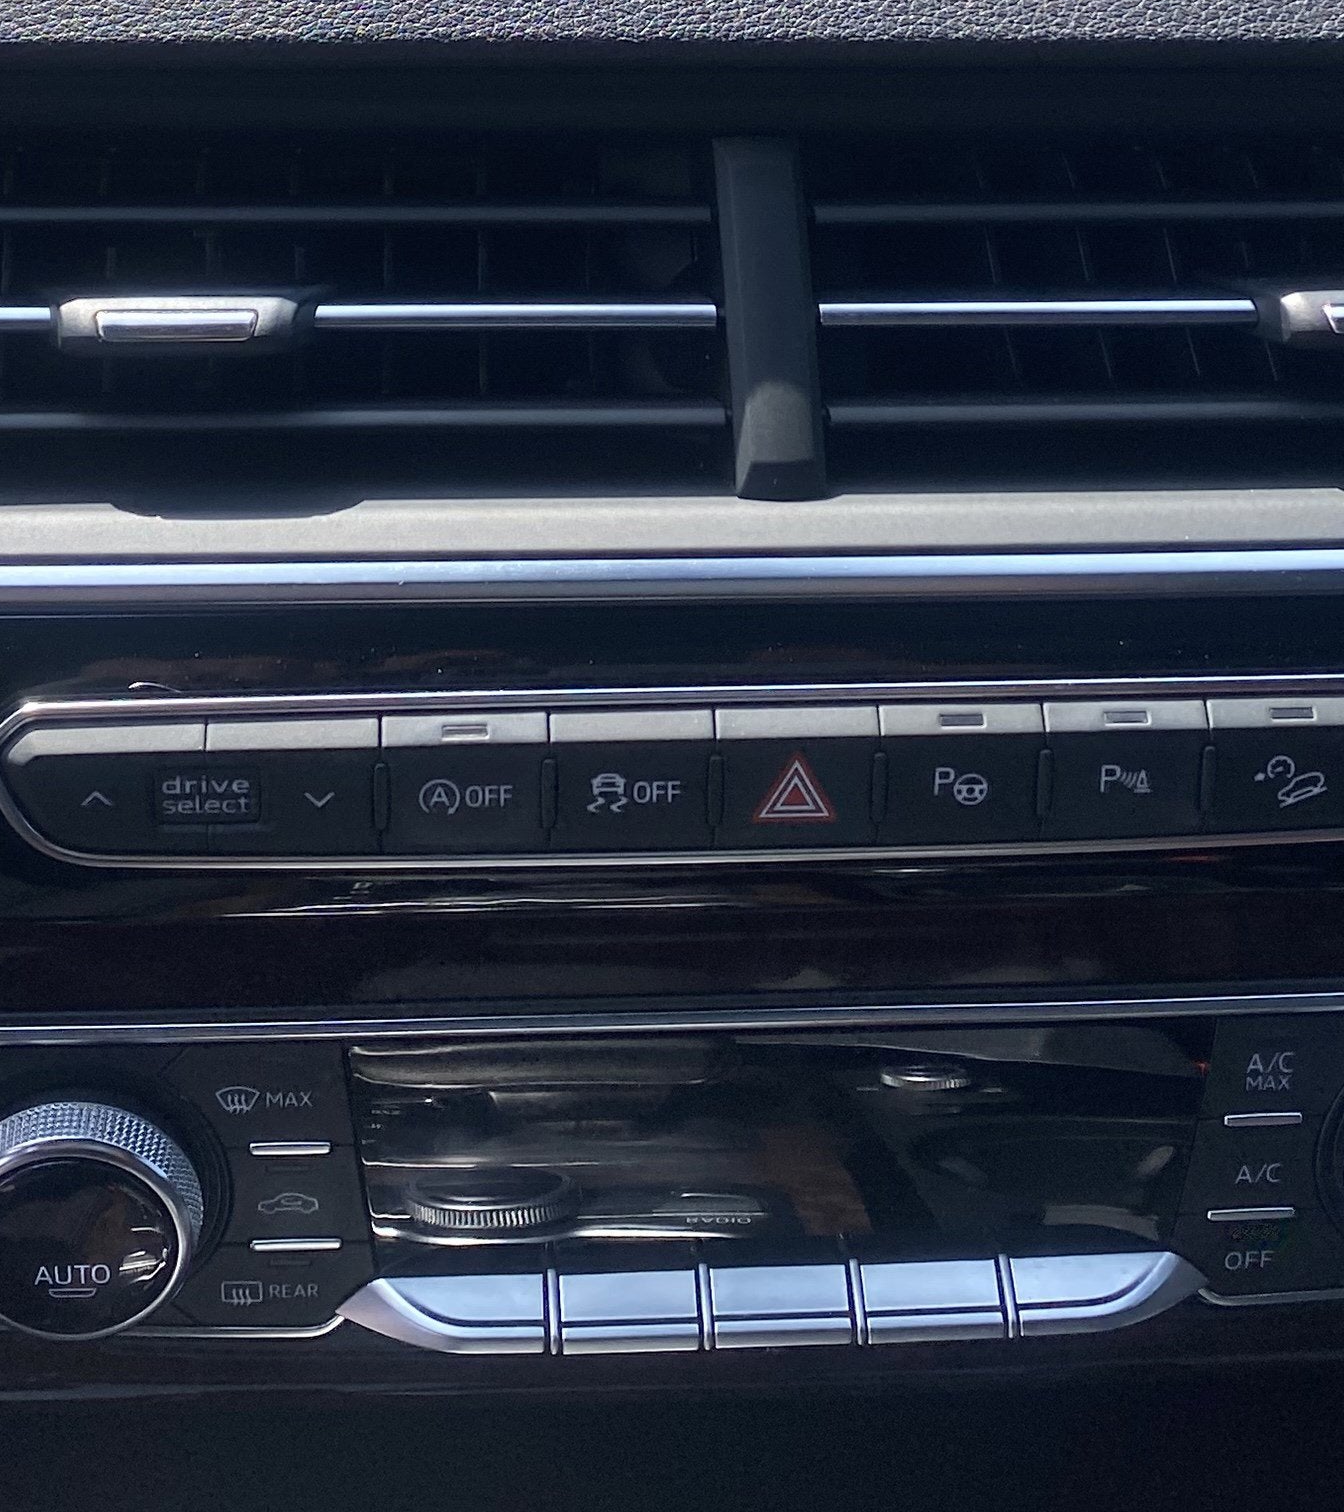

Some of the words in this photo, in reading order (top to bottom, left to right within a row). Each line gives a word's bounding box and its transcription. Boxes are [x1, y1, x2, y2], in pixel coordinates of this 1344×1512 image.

[162, 776, 250, 794] drive
[632, 780, 682, 804] OFF
[162, 795, 250, 815] select
[465, 785, 513, 808] OFF
[1246, 1052, 1295, 1074] A/C
[1246, 1074, 1291, 1091] MAX
[265, 1091, 313, 1108] MAX
[1234, 1162, 1281, 1184] A/C
[1224, 1250, 1274, 1270] OFF
[34, 1264, 111, 1285] AUTO
[269, 1284, 319, 1299] REAR
